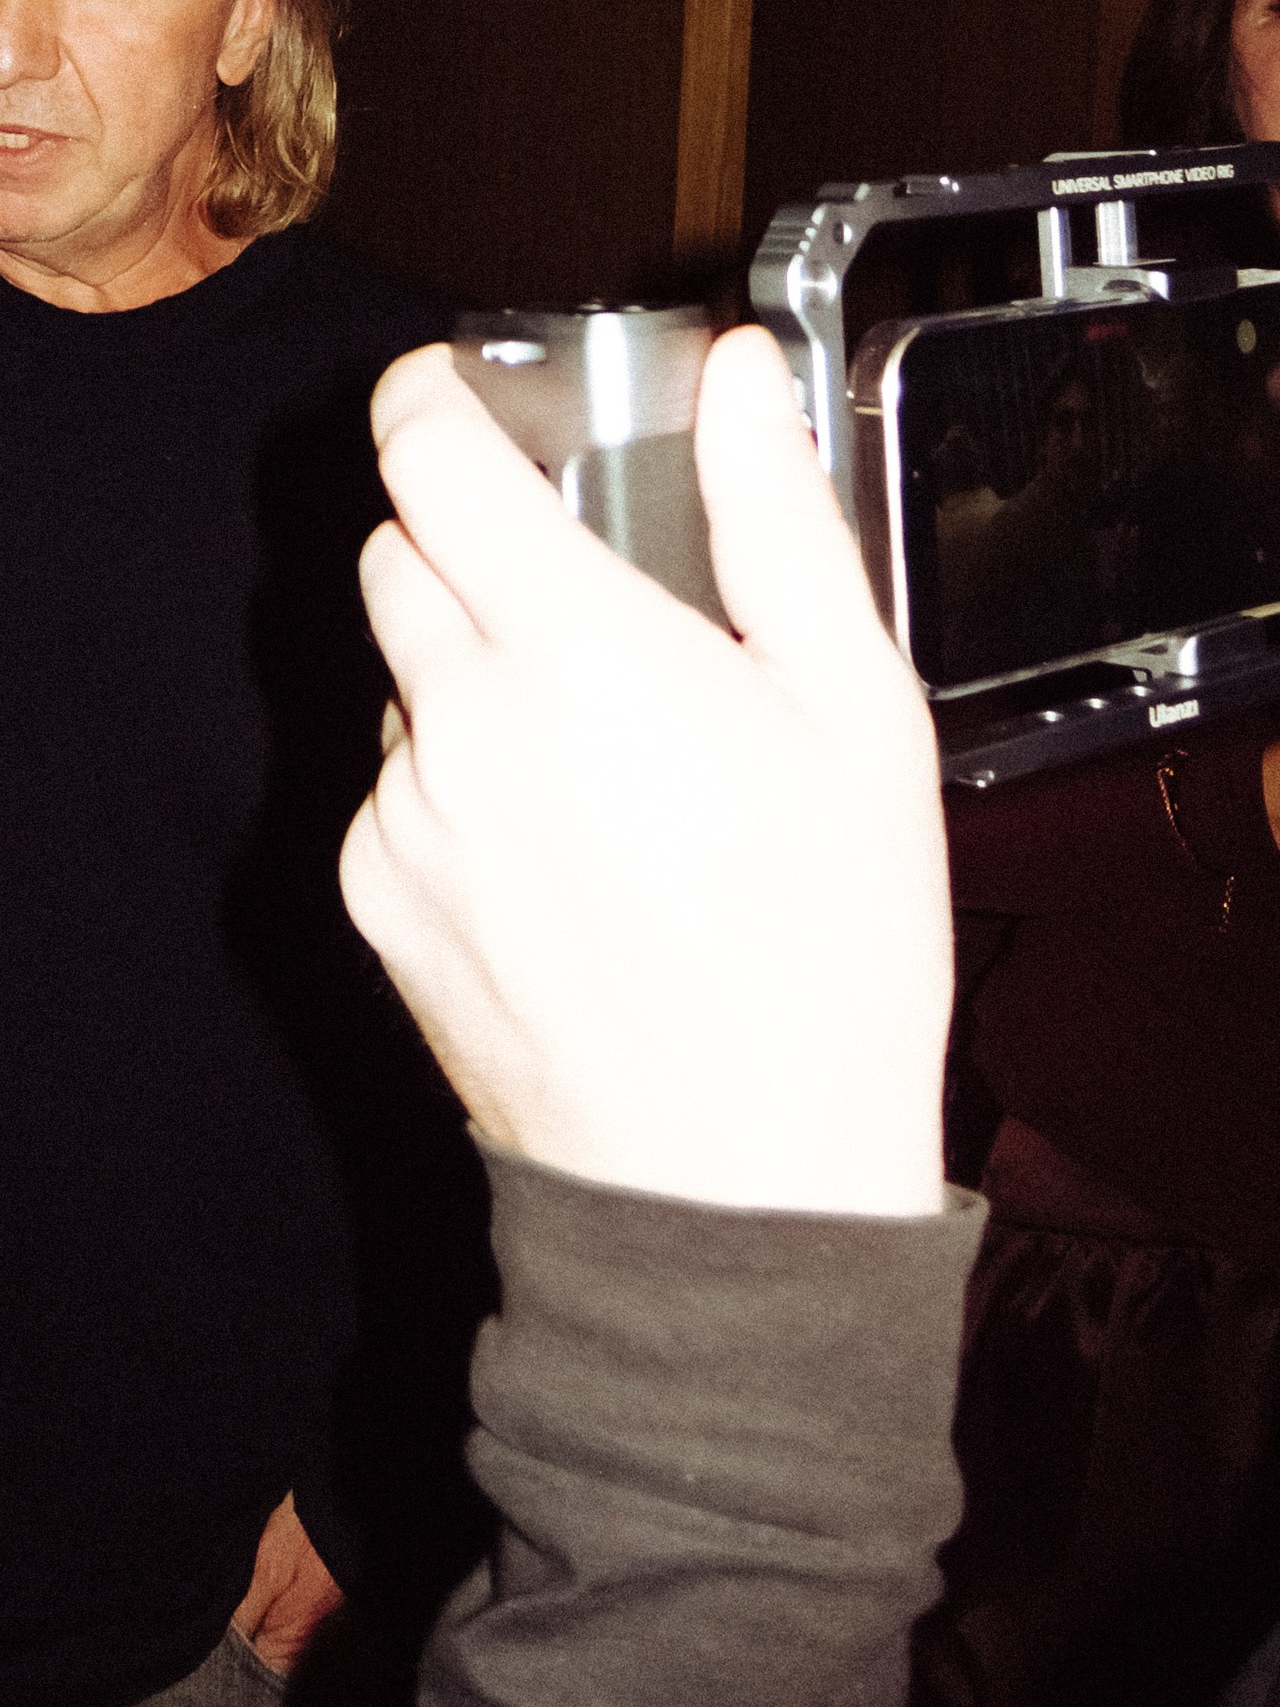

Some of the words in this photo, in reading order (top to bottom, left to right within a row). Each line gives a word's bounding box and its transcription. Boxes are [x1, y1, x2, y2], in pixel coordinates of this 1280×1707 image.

[1052, 176, 1113, 195] UNIVERSAL
[1113, 169, 1184, 190] SMARTPHONE
[1184, 166, 1216, 182] VIDEO
[1216, 164, 1235, 179] RIG
